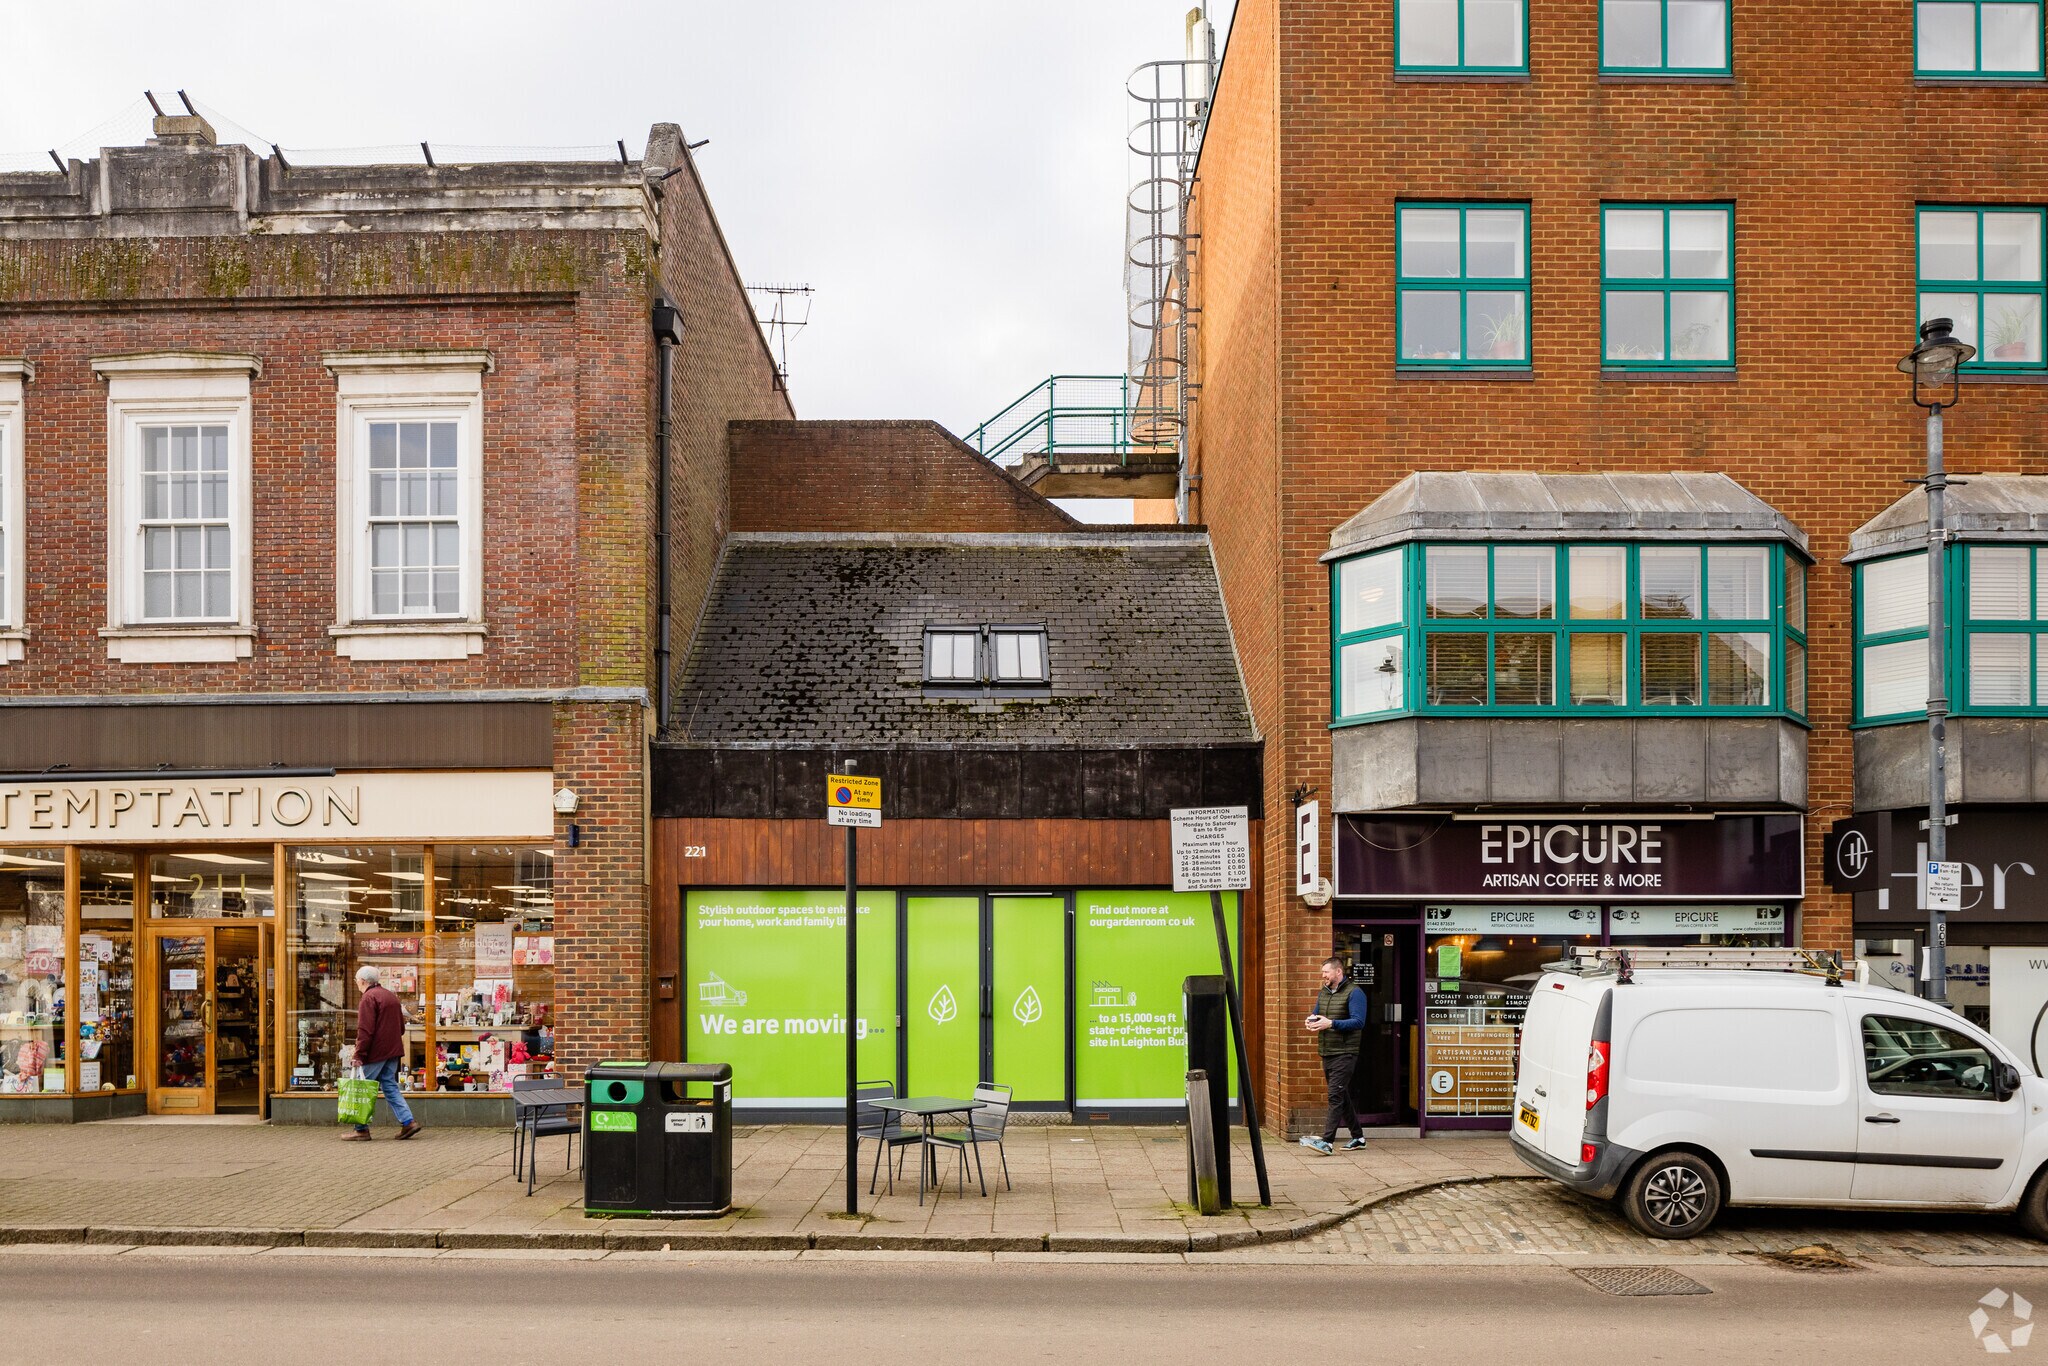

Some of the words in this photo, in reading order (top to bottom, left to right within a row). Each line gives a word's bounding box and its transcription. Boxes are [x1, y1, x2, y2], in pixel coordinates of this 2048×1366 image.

[830, 777, 862, 785] Restricted
[0, 785, 360, 829] TEMPTATION
[1482, 824, 1661, 864] EPICURE
[685, 846, 706, 858] 221
[1931, 864, 1937, 872] P
[1482, 874, 1539, 887] ARTISAN
[1544, 874, 1598, 887] COFFEE
[1604, 874, 1614, 887] &
[1619, 874, 1661, 887] MORE
[189, 874, 246, 899] 211
[699, 905, 736, 916] Stylish
[736, 905, 776, 915] outdoor
[778, 906, 813, 916] spaces
[816, 906, 825, 915] to
[827, 906, 870, 915] enhce
[1089, 905, 1111, 915] Find
[1114, 906, 1129, 915] out
[1159, 906, 1169, 915] at
[699, 918, 721, 928] your
[724, 917, 754, 928] home,
[757, 917, 781, 926] work
[784, 917, 801, 926] and
[804, 917, 834, 928] family
[837, 917, 847, 926] lif
[1490, 912, 1534, 922] EPICURE
[1675, 912, 1719, 922] EPICURE
[1089, 917, 1195, 929] ourgardenroom.co.uk
[700, 1014, 737, 1034] We
[742, 1017, 779, 1034] are
[1099, 1014, 1110, 1023] to
[1119, 1013, 1152, 1024] 15,000
[1154, 1015, 1166, 1024] sq
[1168, 1014, 1176, 1022] ft
[1089, 1026, 1171, 1035] state-of-the-art
[1089, 1038, 1108, 1046] site
[1110, 1038, 1119, 1046] in
[1121, 1037, 1166, 1048] Leighton
[1168, 1038, 1186, 1046] Buz
[1439, 1075, 1447, 1088] E
